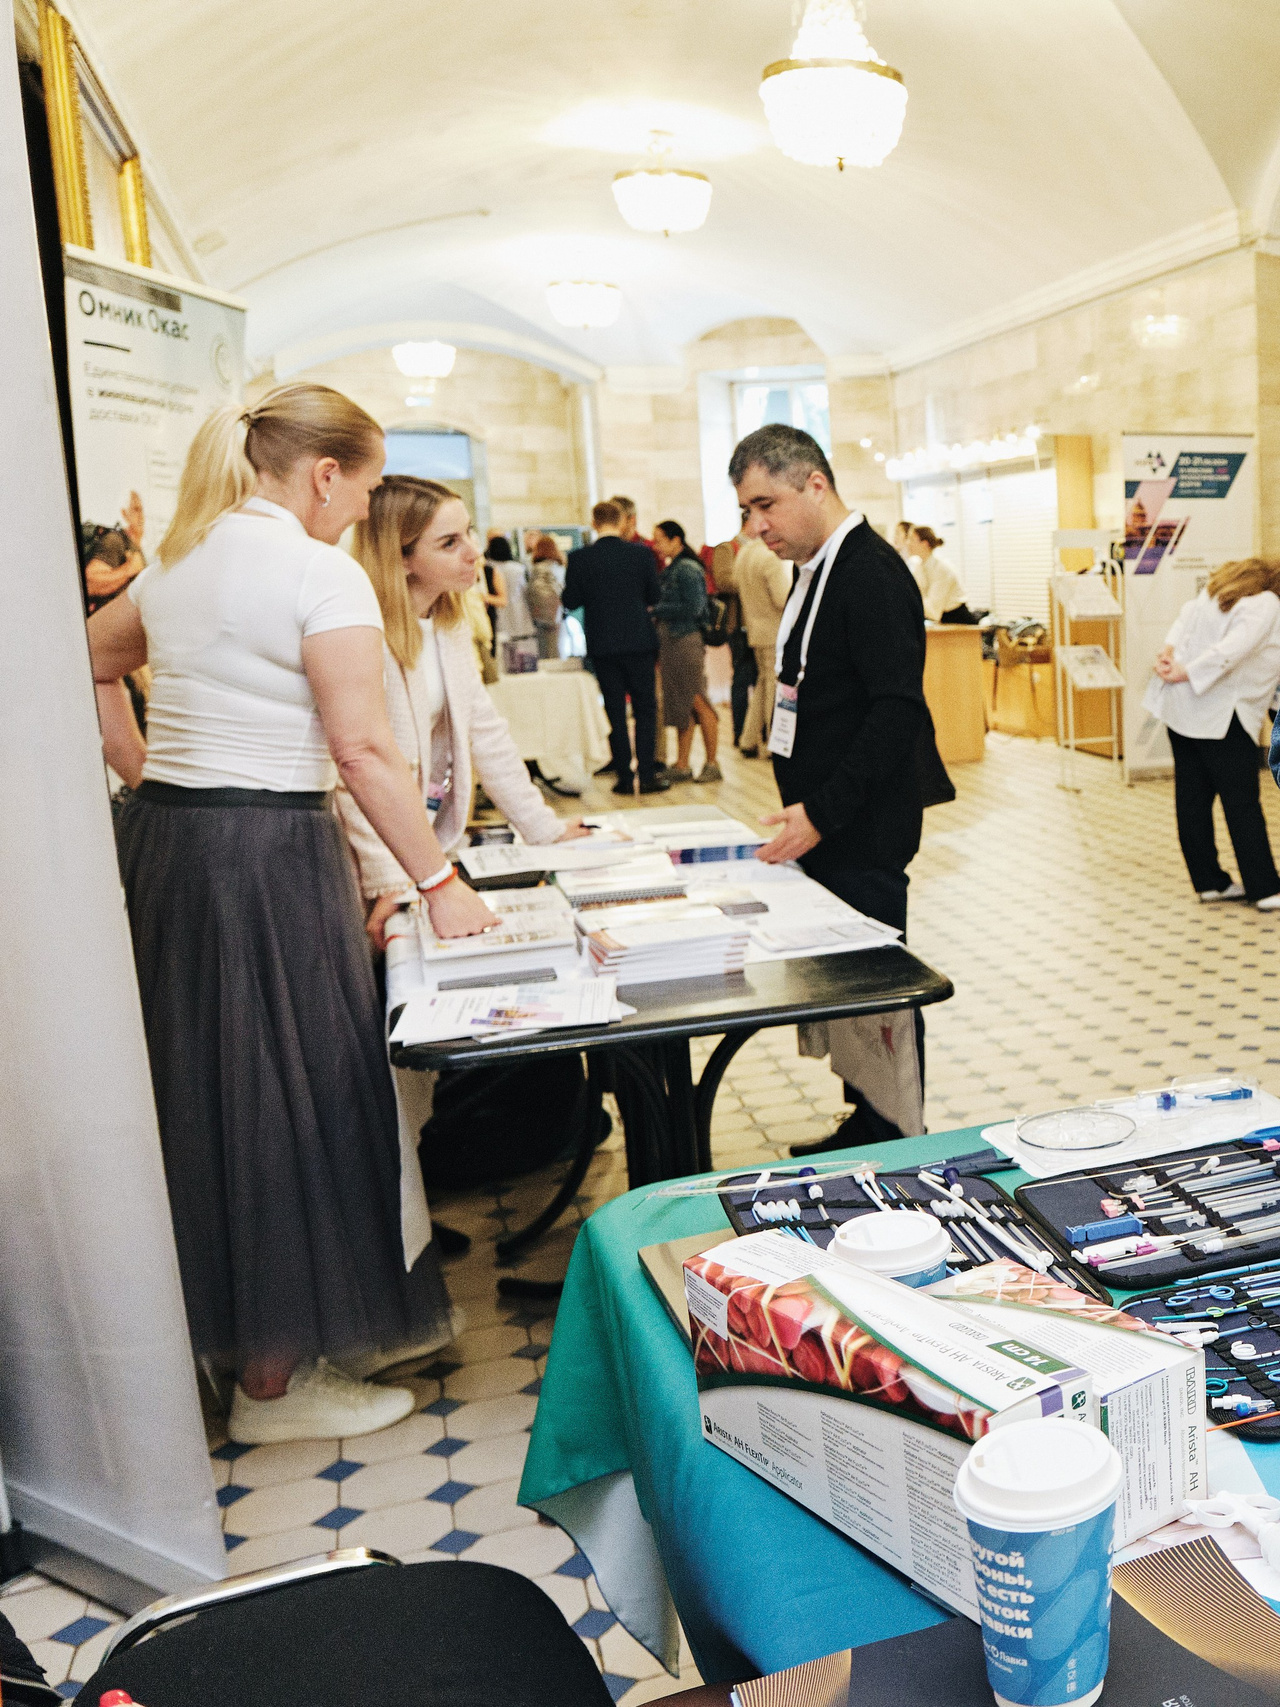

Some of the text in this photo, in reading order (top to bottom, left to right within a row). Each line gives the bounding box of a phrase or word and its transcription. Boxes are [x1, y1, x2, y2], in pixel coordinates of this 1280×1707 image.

[79, 291, 189, 340] Омник Окас
[952, 1350, 972, 1364] AH
[1000, 1343, 1048, 1367] 14 cm
[1185, 1366, 1197, 1415] BARD
[734, 1436, 744, 1451] AH
[1189, 1471, 1199, 1492] AH
[987, 1584, 1035, 1605] есть
[999, 1650, 1028, 1667] Лавка
